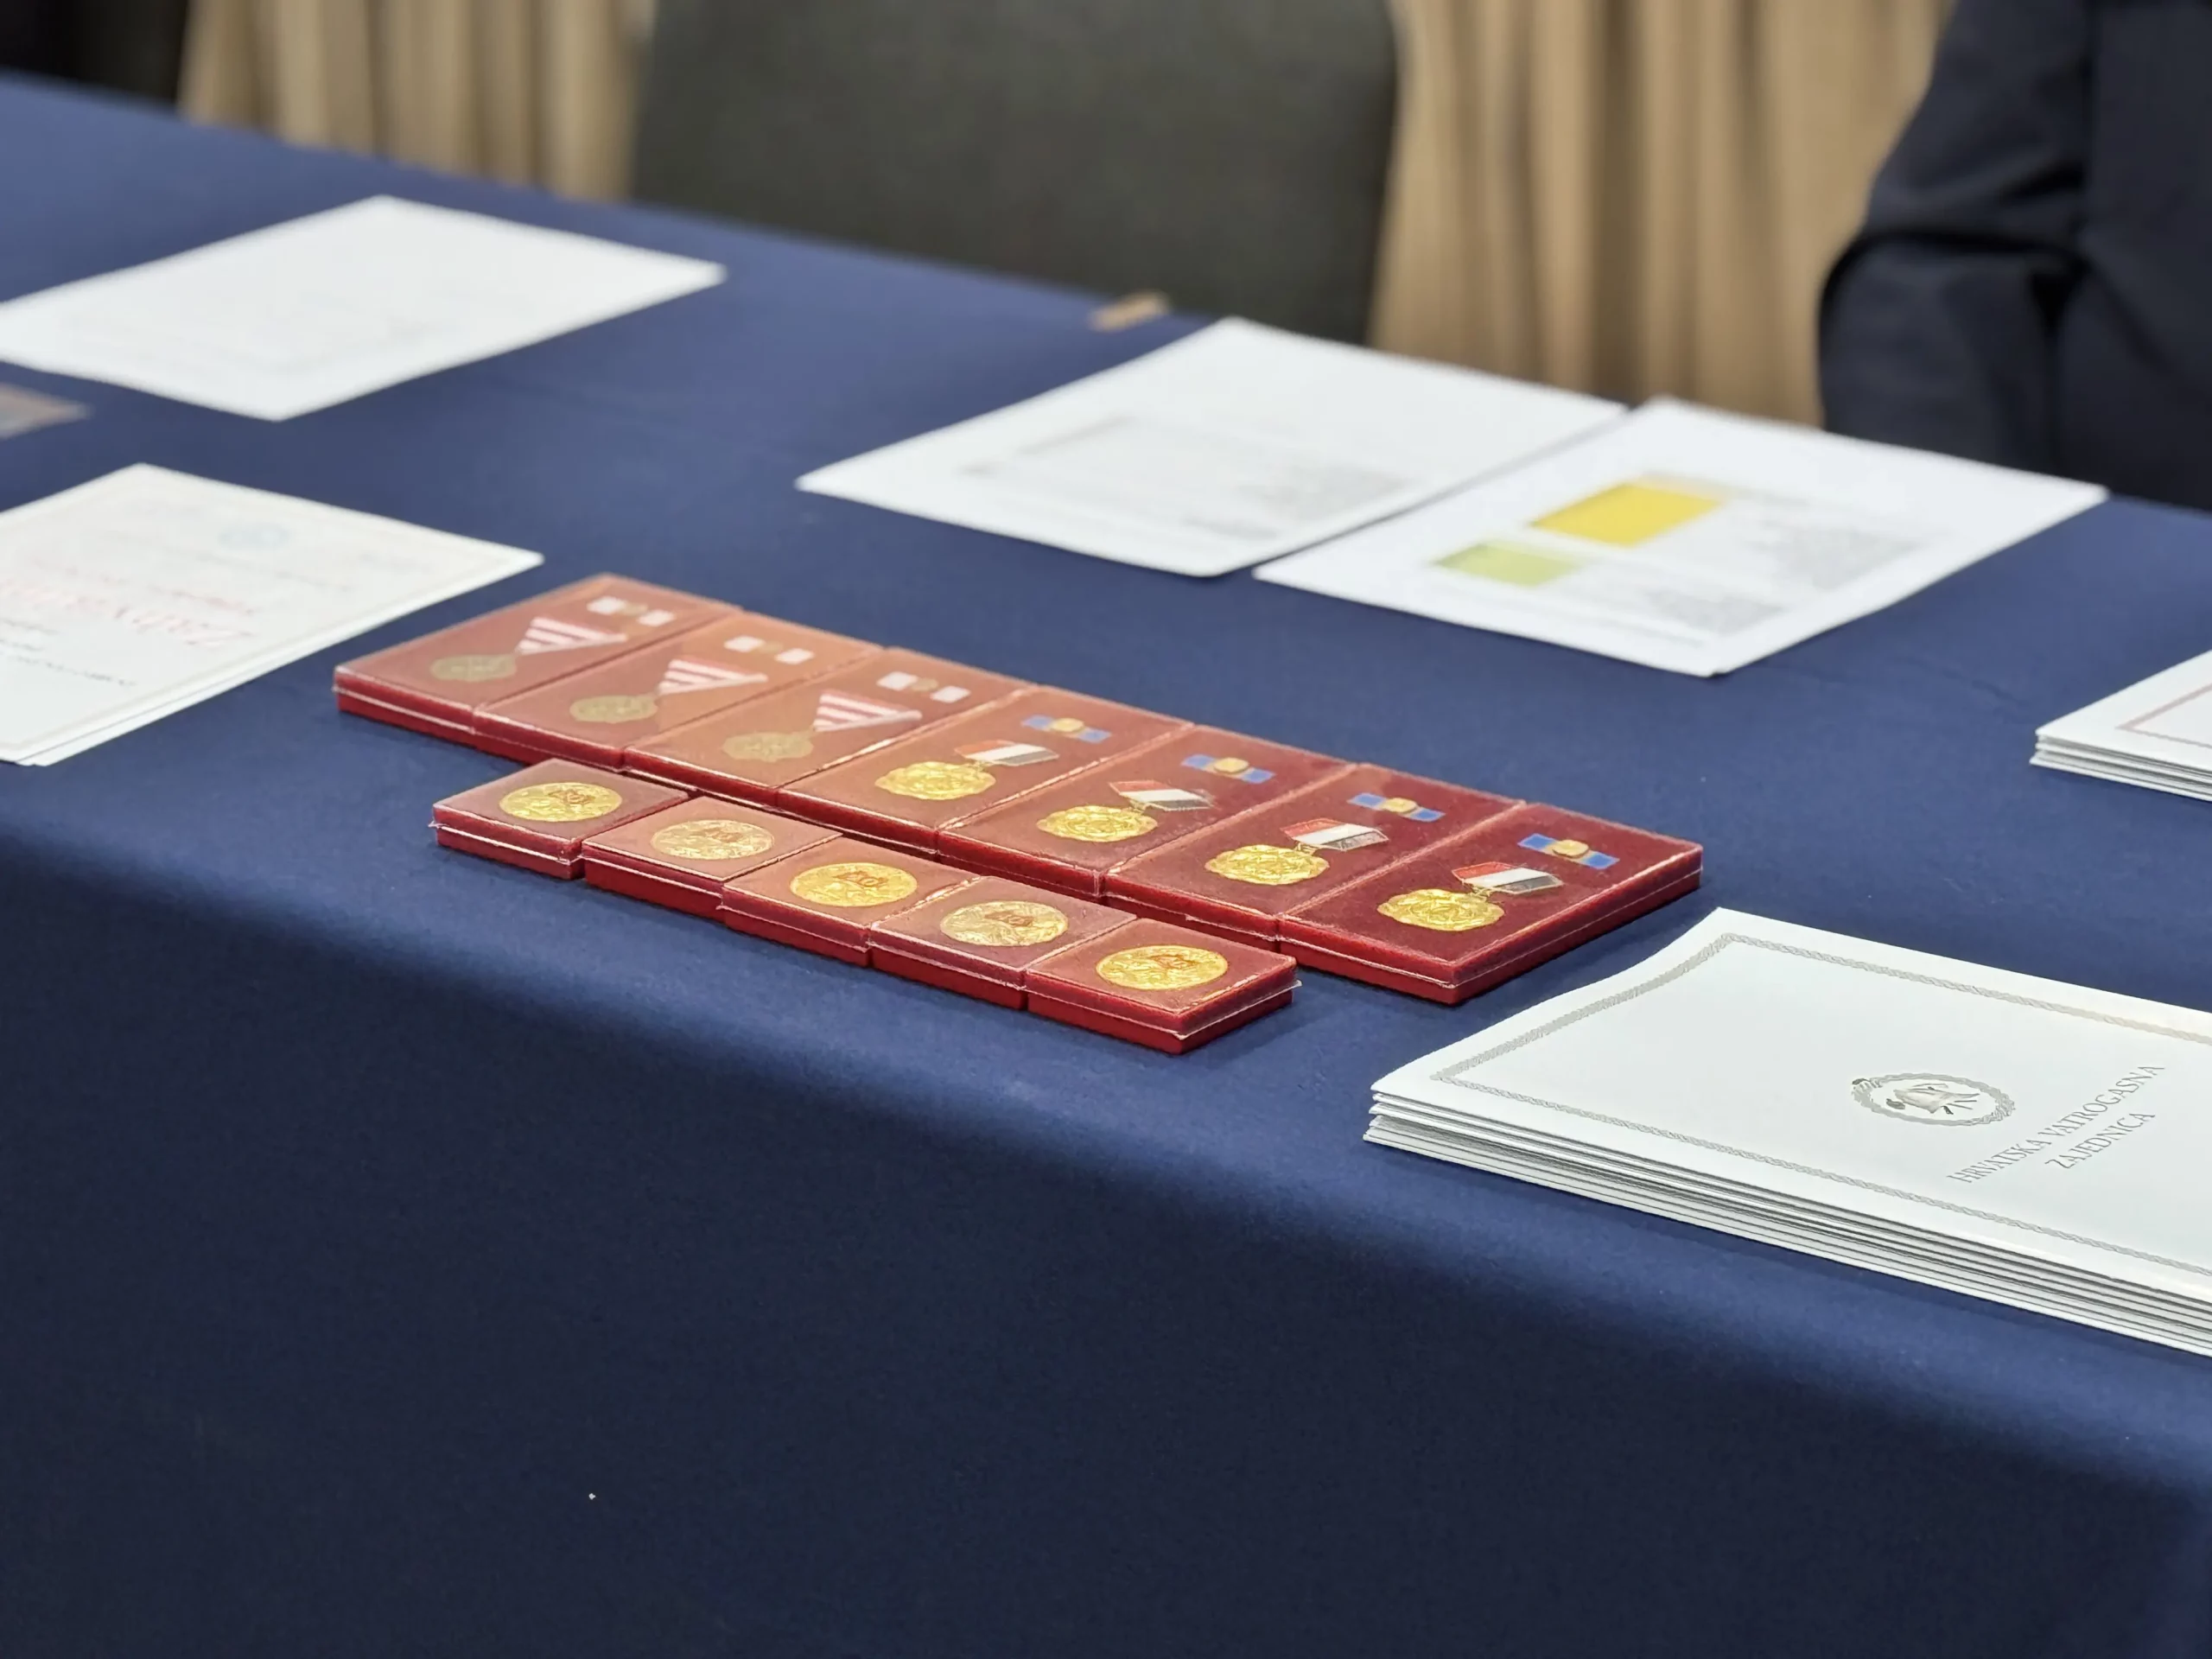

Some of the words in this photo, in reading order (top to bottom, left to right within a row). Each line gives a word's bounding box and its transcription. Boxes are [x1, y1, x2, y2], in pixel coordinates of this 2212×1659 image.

[1947, 1138, 2052, 1183] HRVATSKA
[2037, 1065, 2165, 1137] VATROGASNA
[2044, 1112, 2156, 1170] ZAJEDNICA
